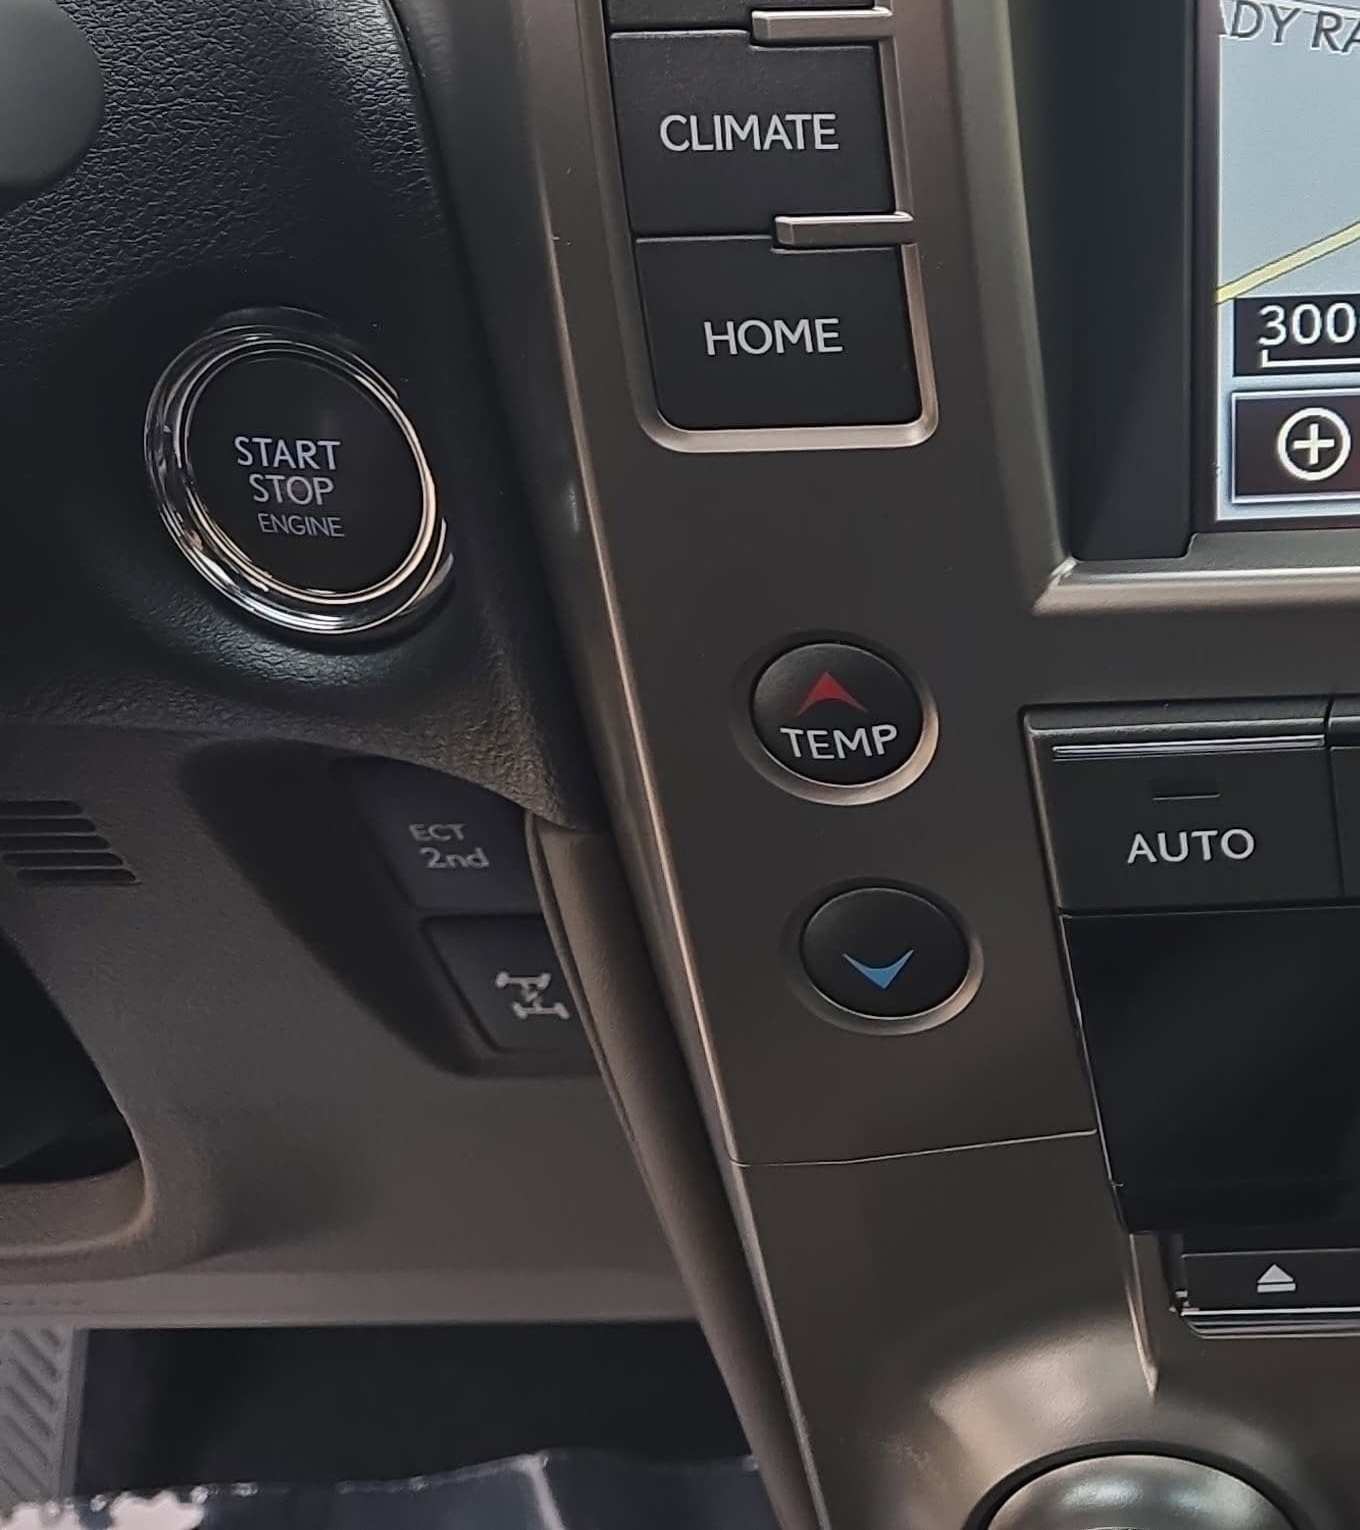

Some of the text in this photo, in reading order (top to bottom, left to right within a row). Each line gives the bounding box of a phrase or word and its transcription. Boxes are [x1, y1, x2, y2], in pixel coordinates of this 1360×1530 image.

[660, 112, 840, 153] CLIMATE
[703, 317, 845, 357] HOME
[234, 435, 342, 472] START
[248, 473, 335, 507] STOP
[257, 512, 346, 539] ENGINE
[780, 723, 900, 762] TEMP
[410, 821, 467, 843] ECT
[1126, 826, 1257, 866] AUTO
[420, 842, 491, 870] 2nd
